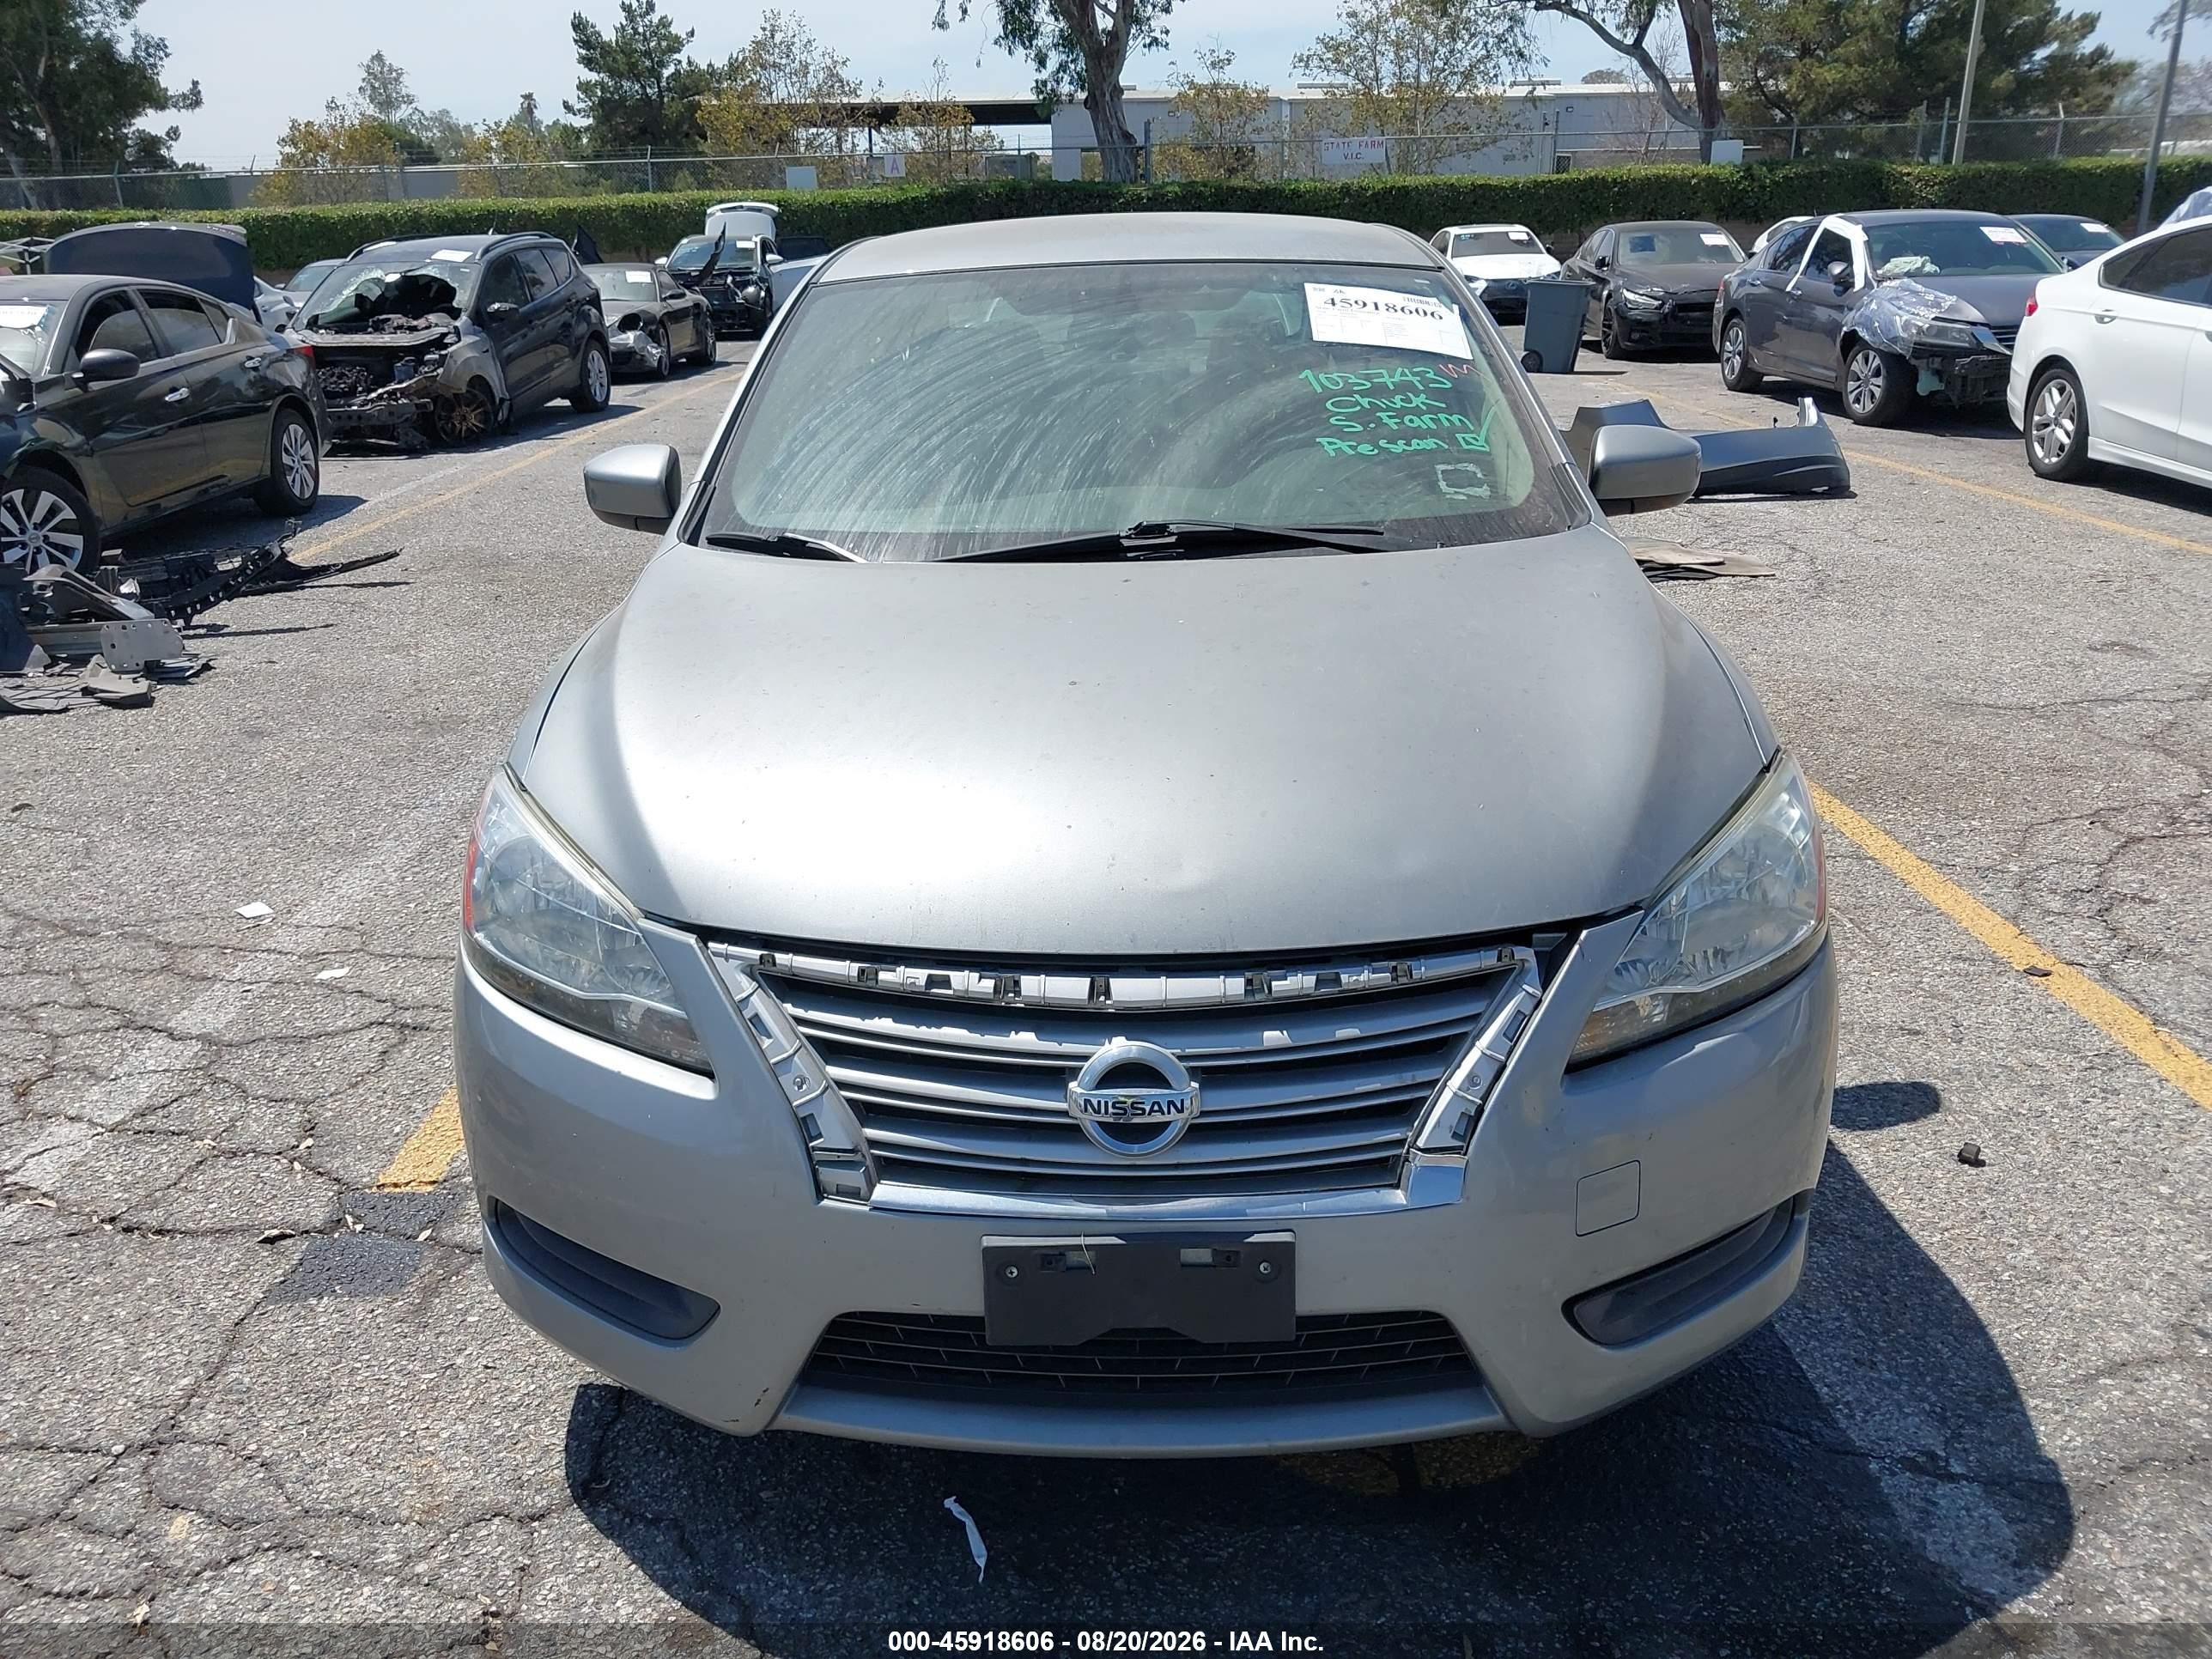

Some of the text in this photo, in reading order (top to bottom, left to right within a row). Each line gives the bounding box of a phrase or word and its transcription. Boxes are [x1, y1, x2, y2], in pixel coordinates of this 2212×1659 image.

[1358, 140, 1384, 150] FARM
[890, 156, 900, 174] A
[1323, 296, 1443, 321] 45918606
[1298, 367, 1453, 394] 103743
[1328, 416, 1376, 432] S.
[1083, 1098, 1185, 1116] NISSAN
